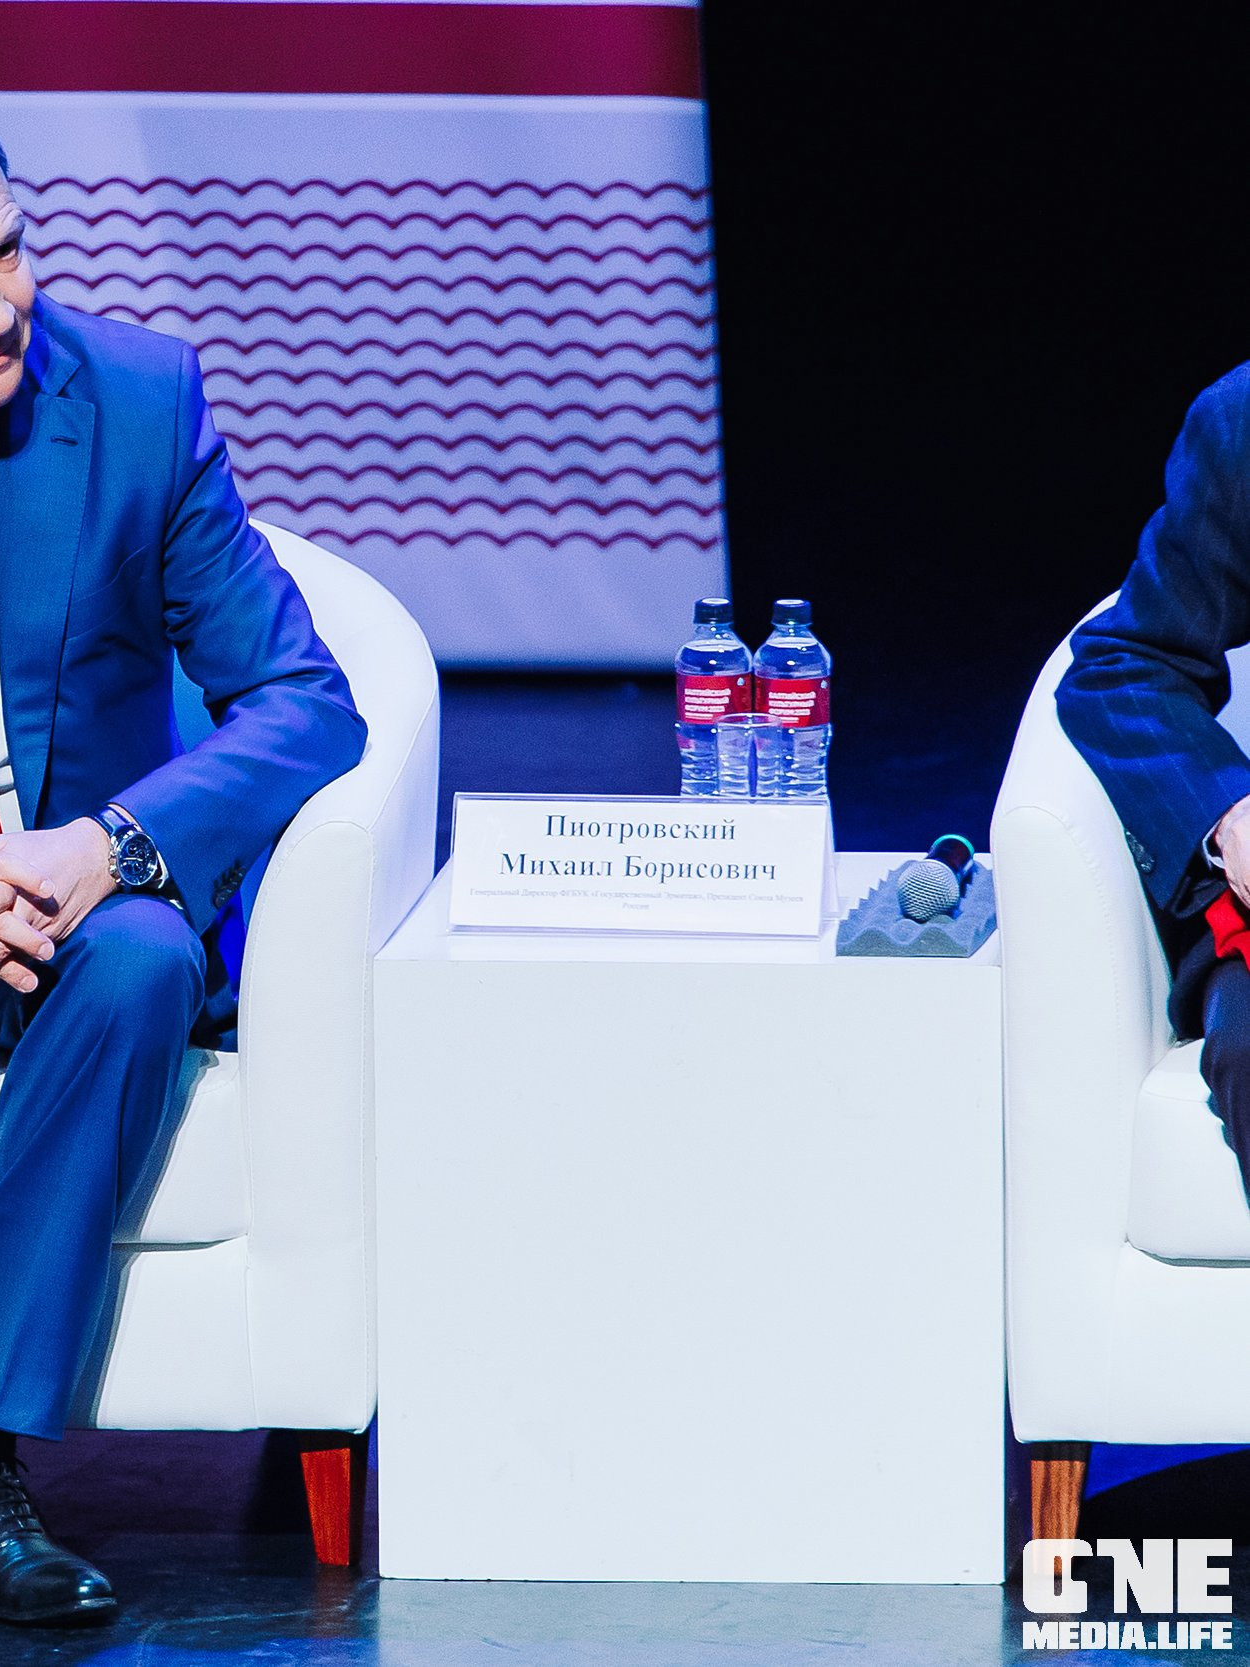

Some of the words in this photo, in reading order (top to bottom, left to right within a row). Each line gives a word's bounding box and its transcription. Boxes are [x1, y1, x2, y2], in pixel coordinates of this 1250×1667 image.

[545, 814, 736, 844] Пиотровский
[498, 852, 613, 878] Михаил
[624, 855, 777, 884] Борисович
